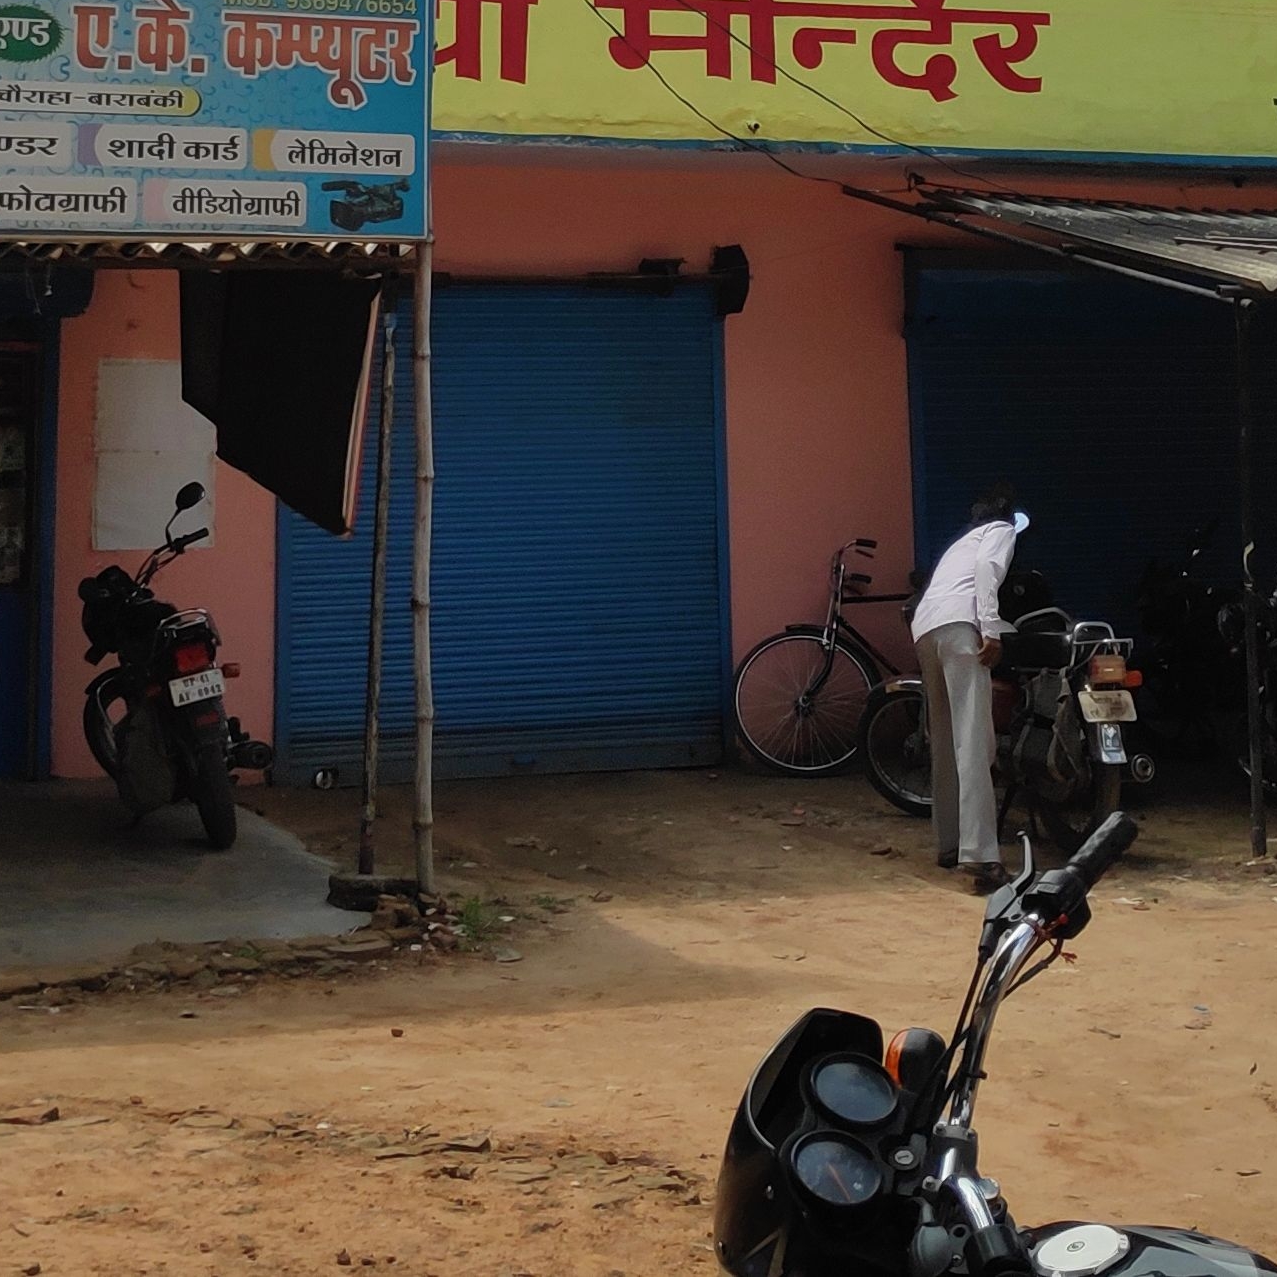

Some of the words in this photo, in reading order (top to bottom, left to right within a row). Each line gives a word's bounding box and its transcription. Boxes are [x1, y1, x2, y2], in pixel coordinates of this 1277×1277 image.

[223, 10, 419, 108] कम्प्यूटर
[107, 132, 176, 160] शादी
[183, 134, 242, 161] कार्ड
[287, 137, 403, 168] लेमिनेशन
[172, 186, 302, 217] वीडियोग्राफी
